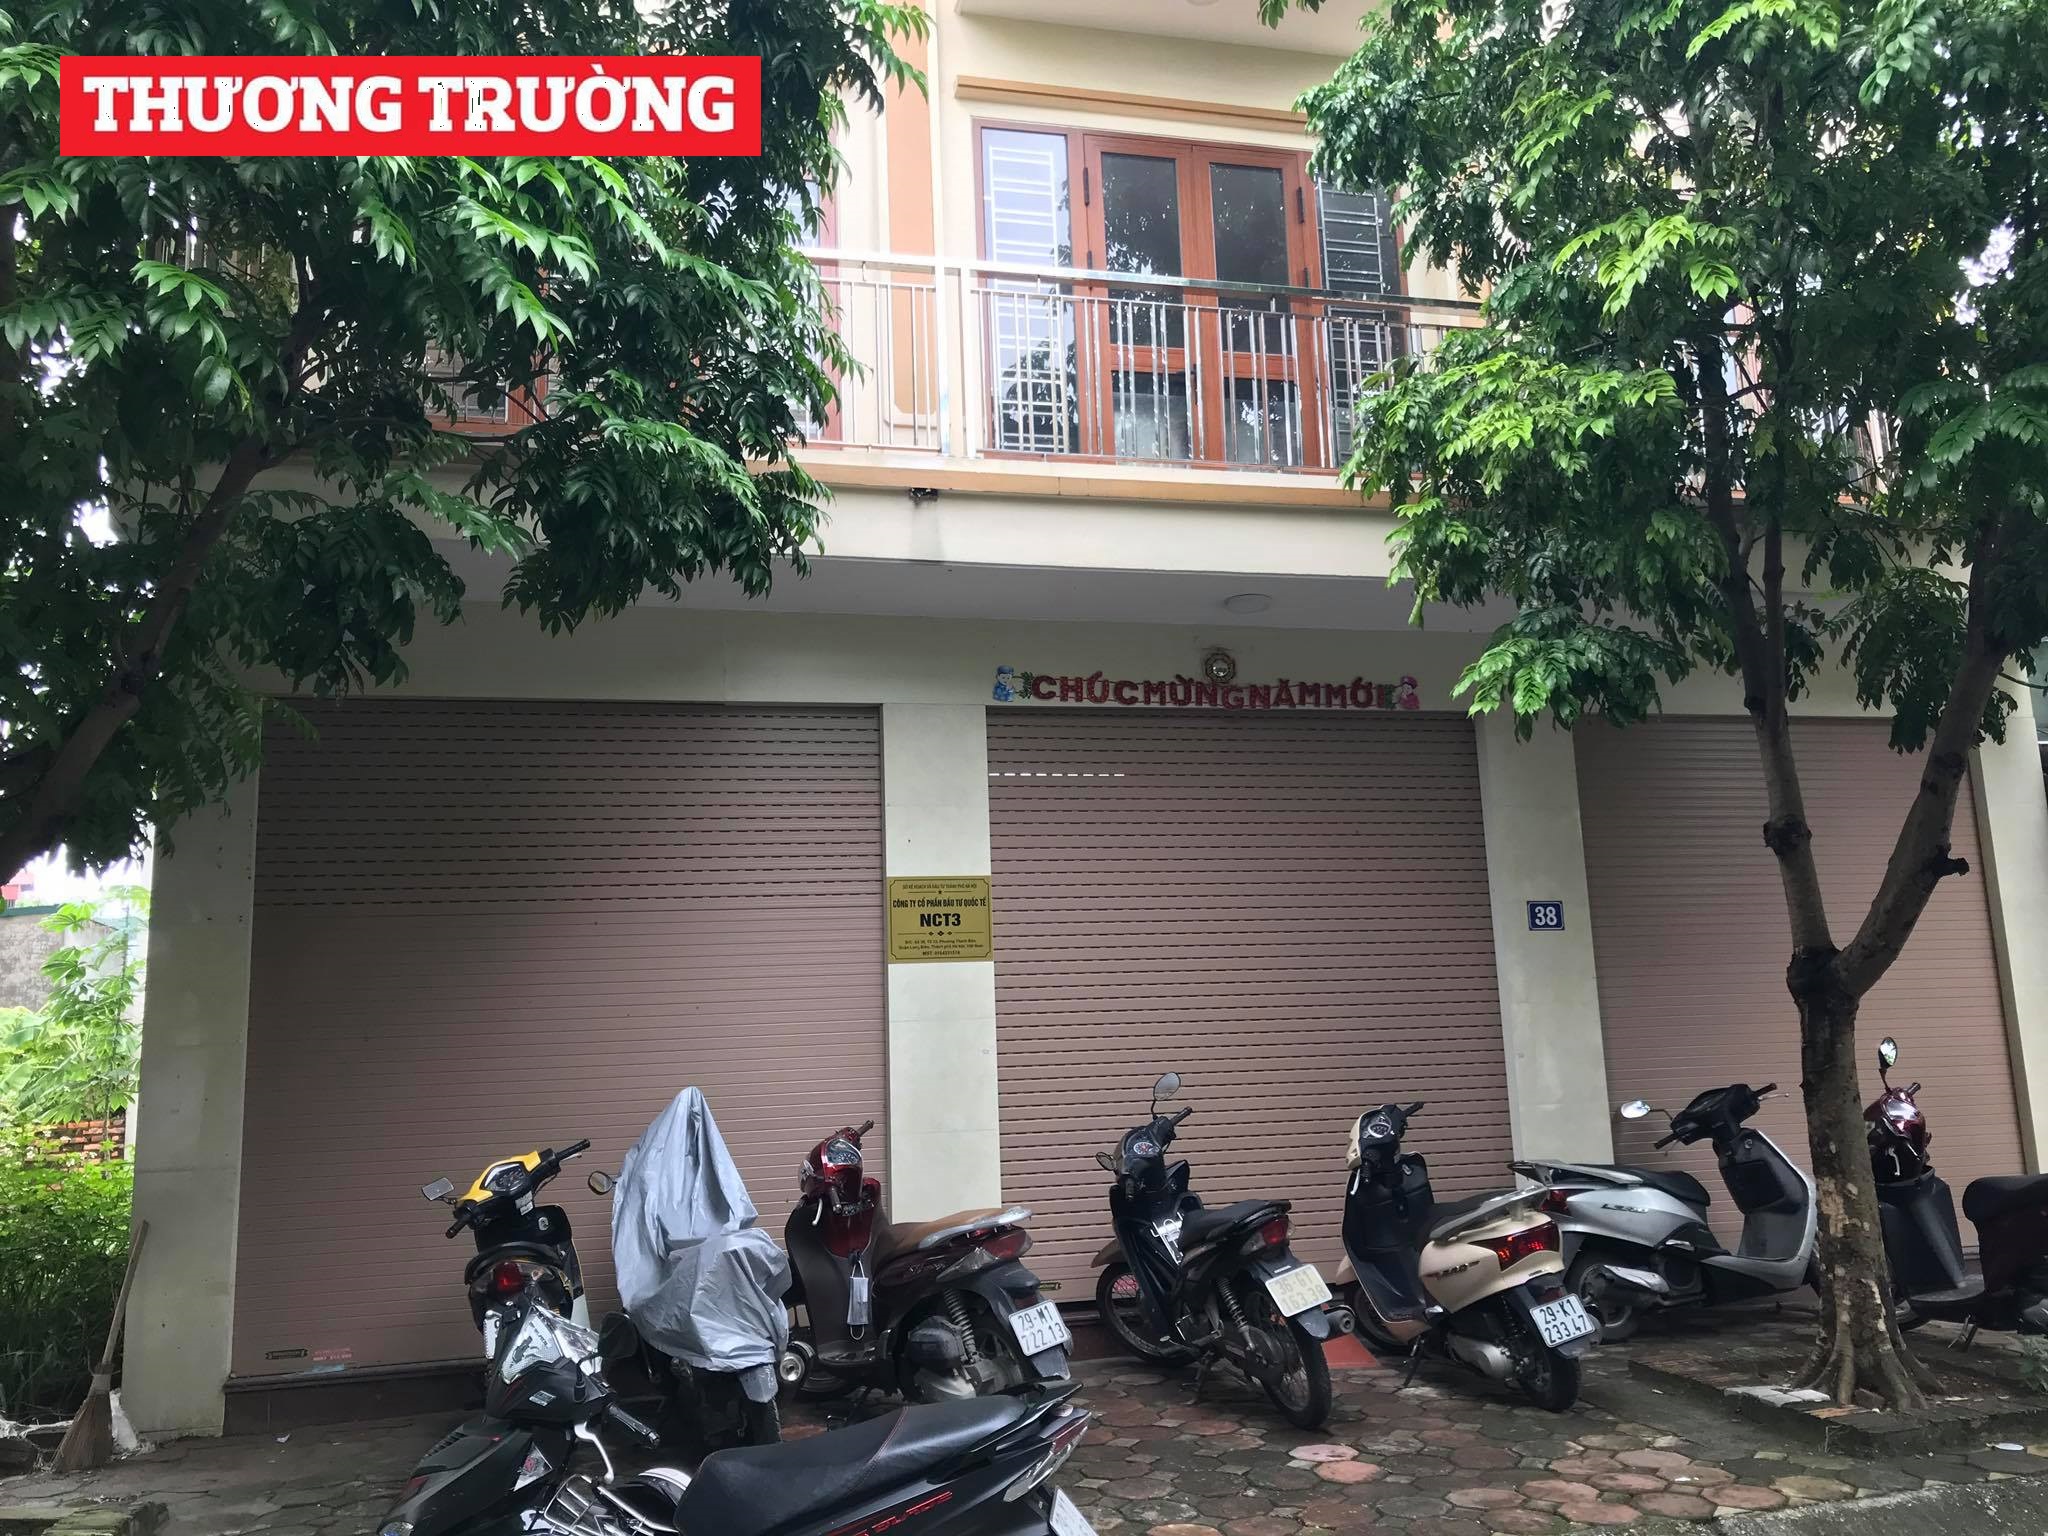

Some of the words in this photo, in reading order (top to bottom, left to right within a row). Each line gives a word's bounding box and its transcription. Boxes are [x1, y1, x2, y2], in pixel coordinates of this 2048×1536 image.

[893, 898, 909, 908] CÔNG
[909, 900, 916, 908] TY
[955, 898, 964, 907] TƯ
[979, 896, 987, 907] TẾ
[920, 913, 961, 927] NCT3
[1535, 906, 1557, 926] 38
[1540, 1299, 1577, 1325] 29-K1
[1544, 1314, 1588, 1344] 233.47
